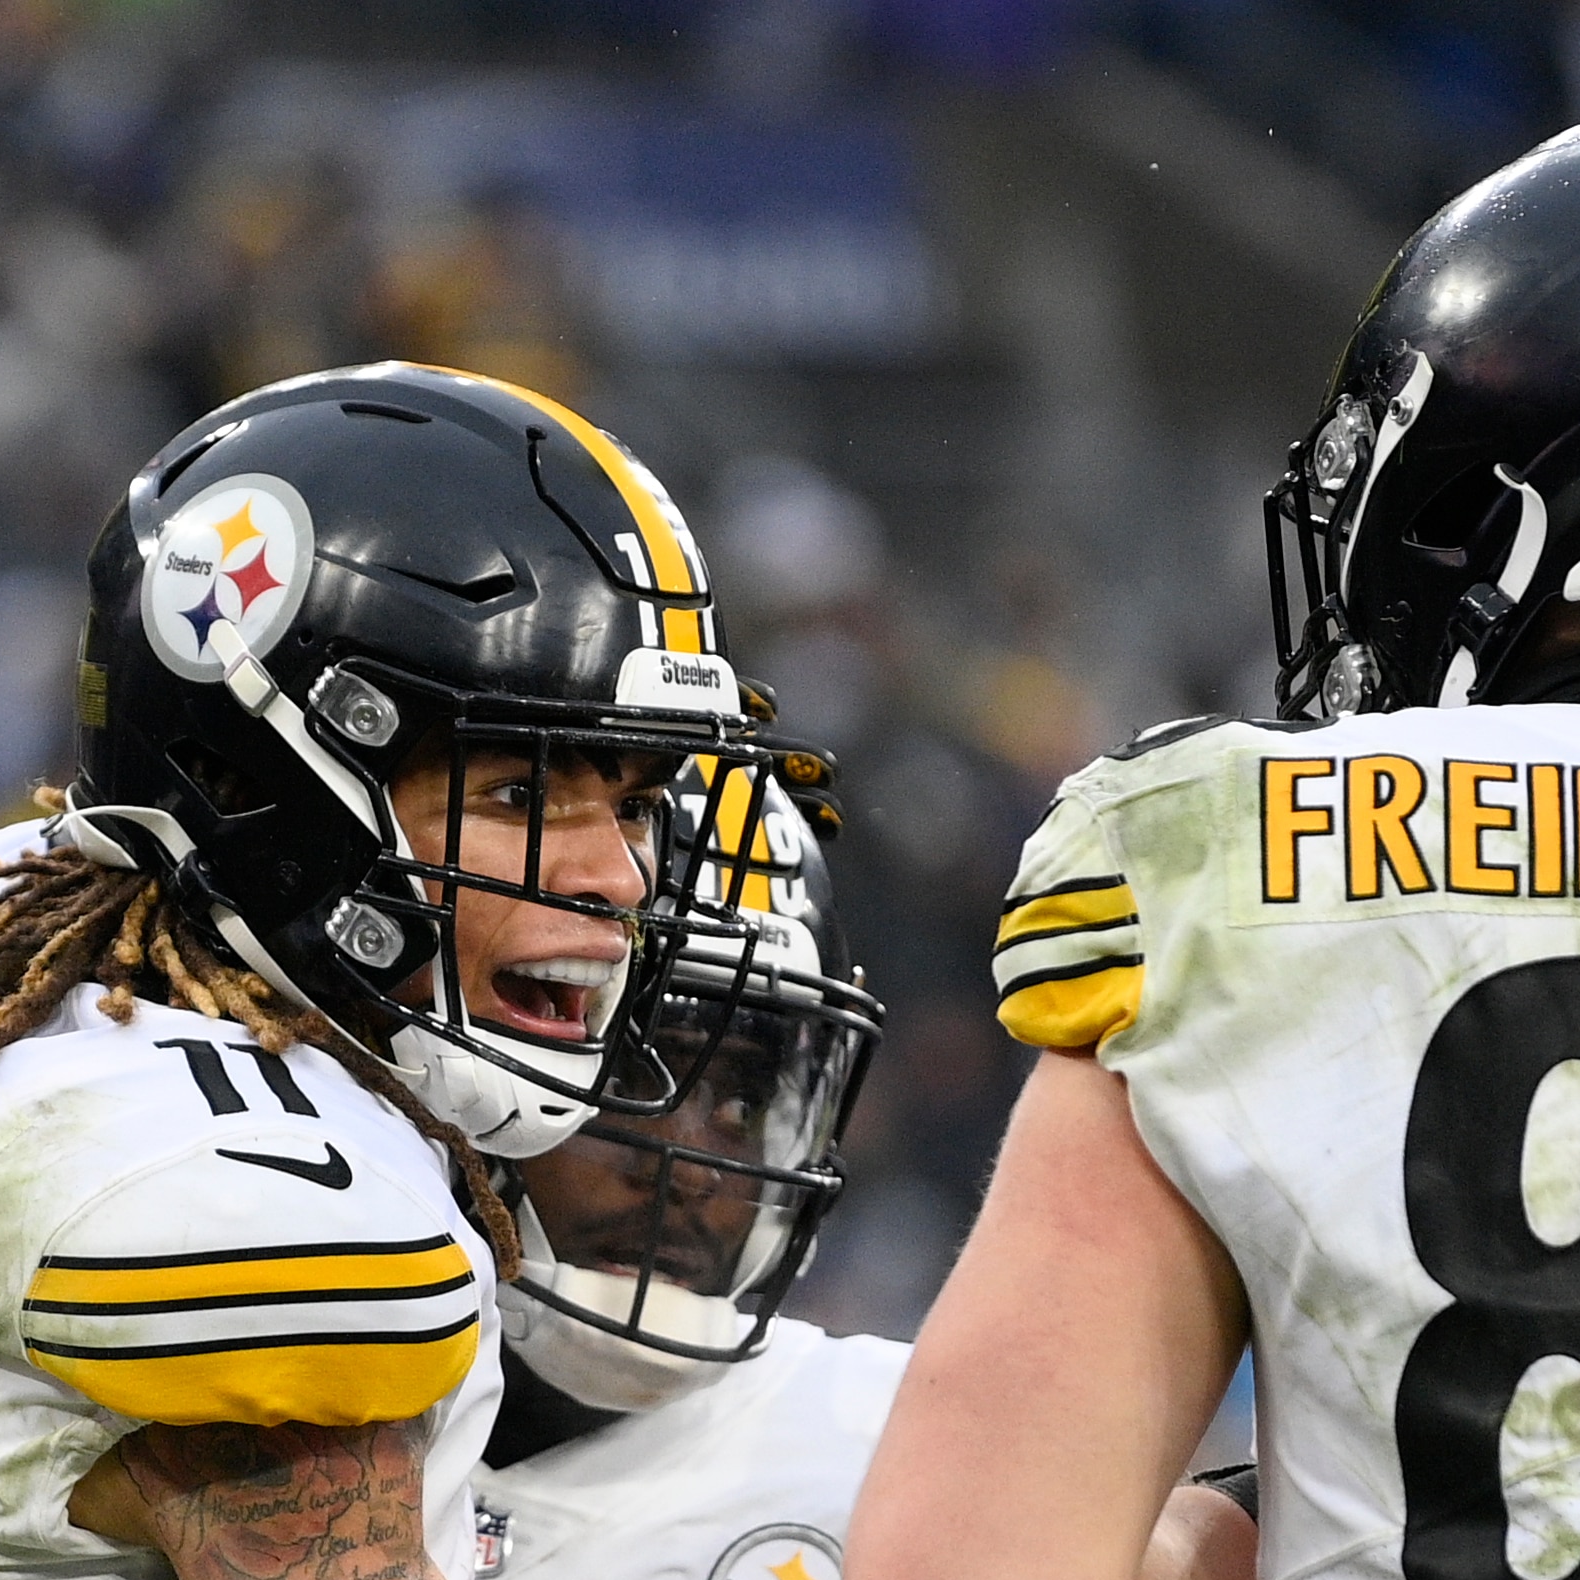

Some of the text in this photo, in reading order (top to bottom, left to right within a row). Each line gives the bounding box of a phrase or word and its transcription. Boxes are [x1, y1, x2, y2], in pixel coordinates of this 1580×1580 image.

[165, 551, 214, 576] Steelers
[660, 655, 721, 689] Steelers
[153, 1038, 321, 1119] 11
